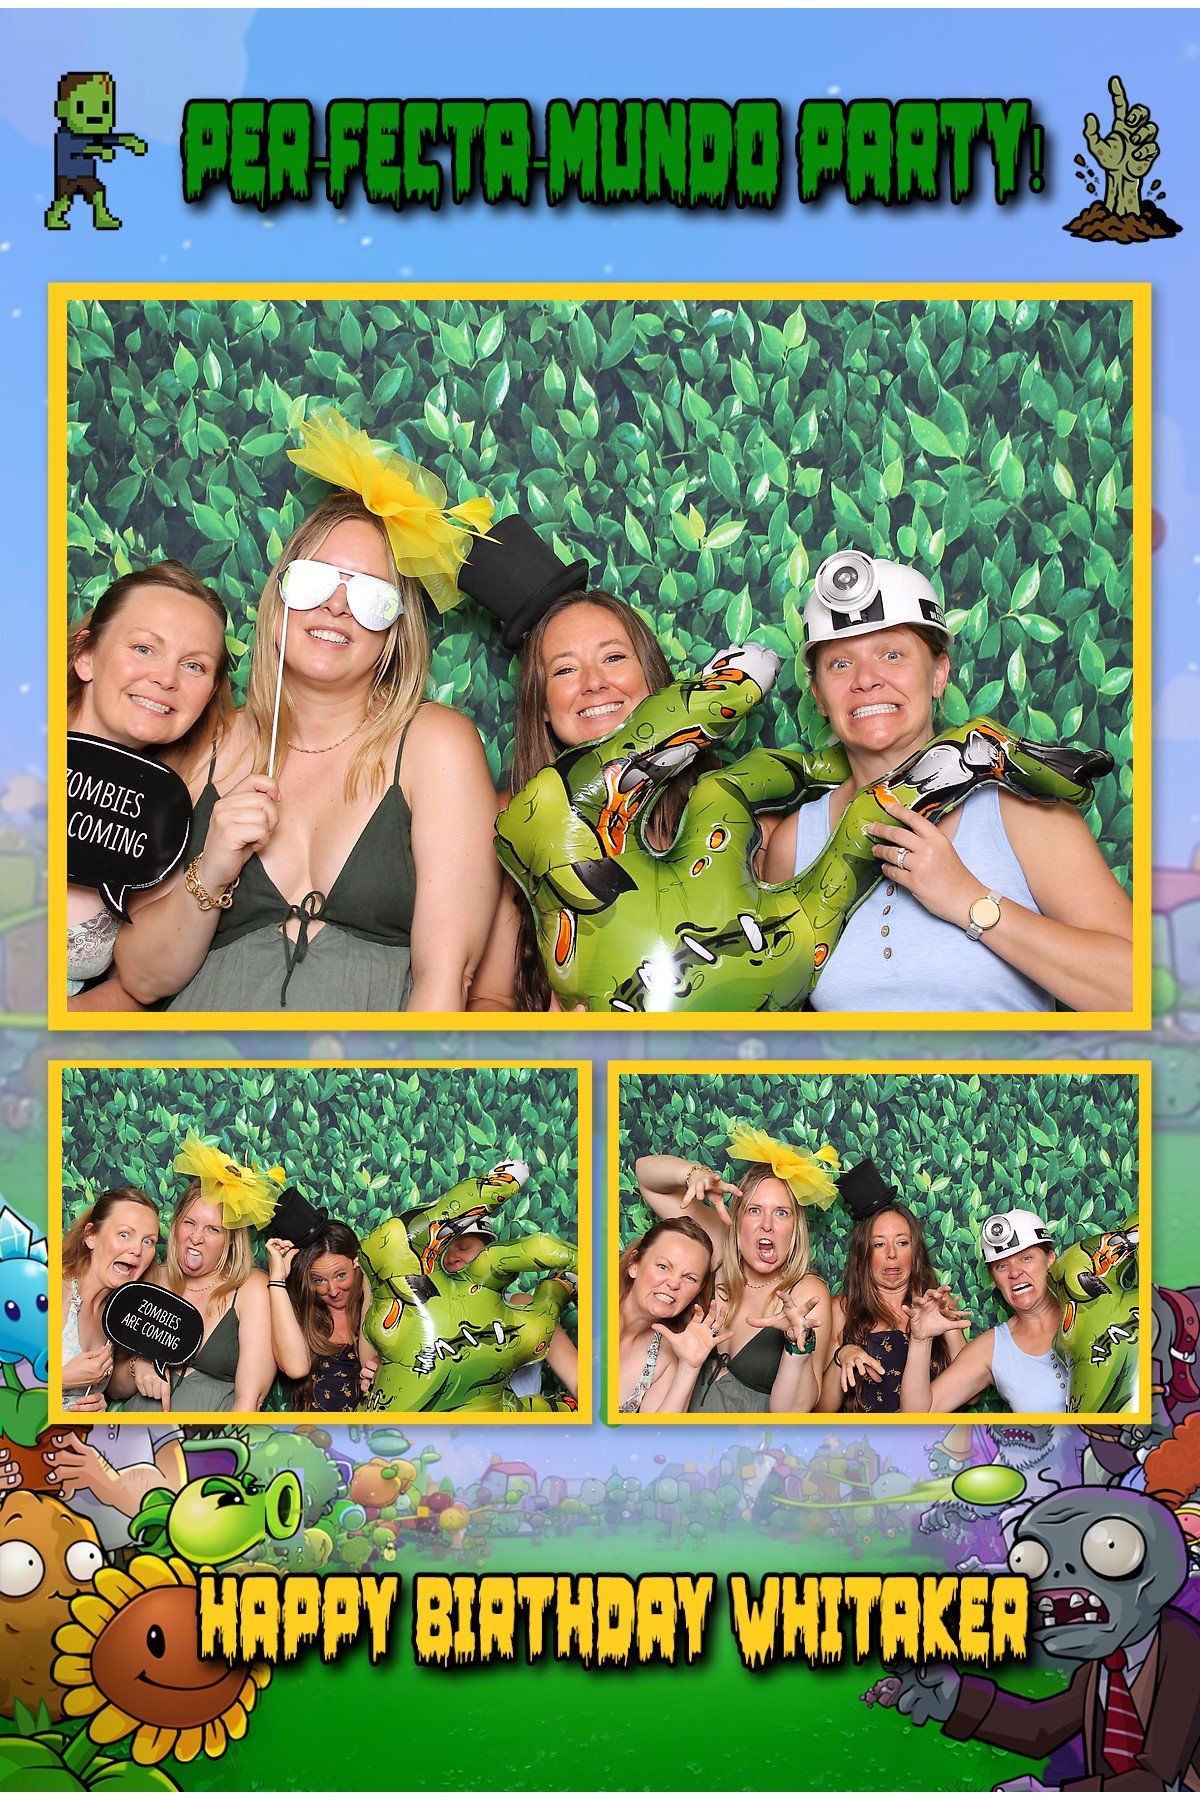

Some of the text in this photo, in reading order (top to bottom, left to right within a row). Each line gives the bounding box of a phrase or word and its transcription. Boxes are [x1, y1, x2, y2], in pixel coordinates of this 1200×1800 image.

[68, 811, 147, 858] COMING
[120, 1312, 180, 1350] ARE COMING
[137, 1299, 181, 1330] ZOMBIES
